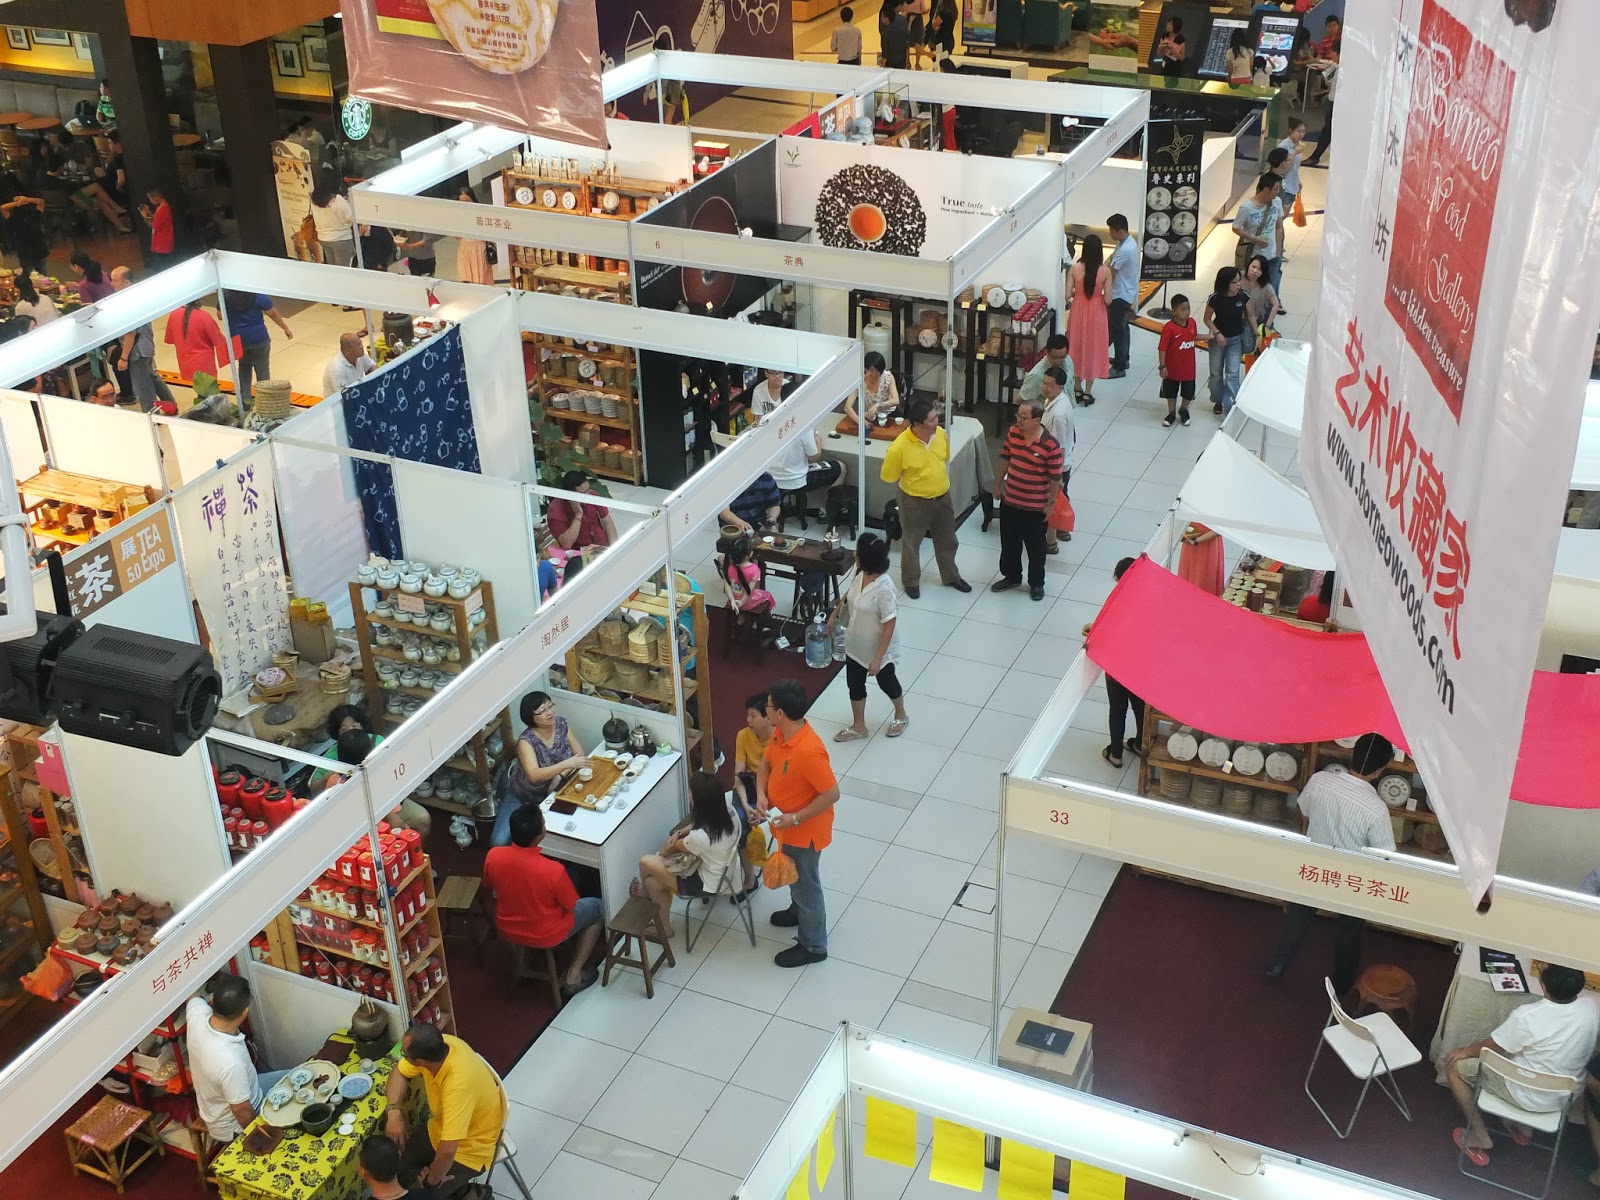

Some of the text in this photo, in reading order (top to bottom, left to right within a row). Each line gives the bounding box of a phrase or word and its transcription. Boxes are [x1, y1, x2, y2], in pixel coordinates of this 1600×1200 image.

[1415, 37, 1501, 182] Borneo
[475, 216, 512, 230] 普洱茶业
[940, 196, 965, 208] True
[1427, 160, 1471, 242] Wood
[655, 240, 661, 250] 6
[1427, 253, 1474, 345] Gallery
[1406, 293, 1432, 343] hidden
[1430, 332, 1464, 393] treasure
[1335, 314, 1472, 661] 艺术收藏家
[120, 522, 163, 561] 展 TEA
[126, 547, 166, 584] 5.0 Expo
[75, 554, 115, 608] 茶
[1326, 420, 1456, 715] www.borneowoods.com
[394, 763, 405, 780] 10
[1050, 809, 1070, 825] 33
[1298, 863, 1411, 905] 杨聘号茶业
[152, 929, 215, 995] 与茶共禅
